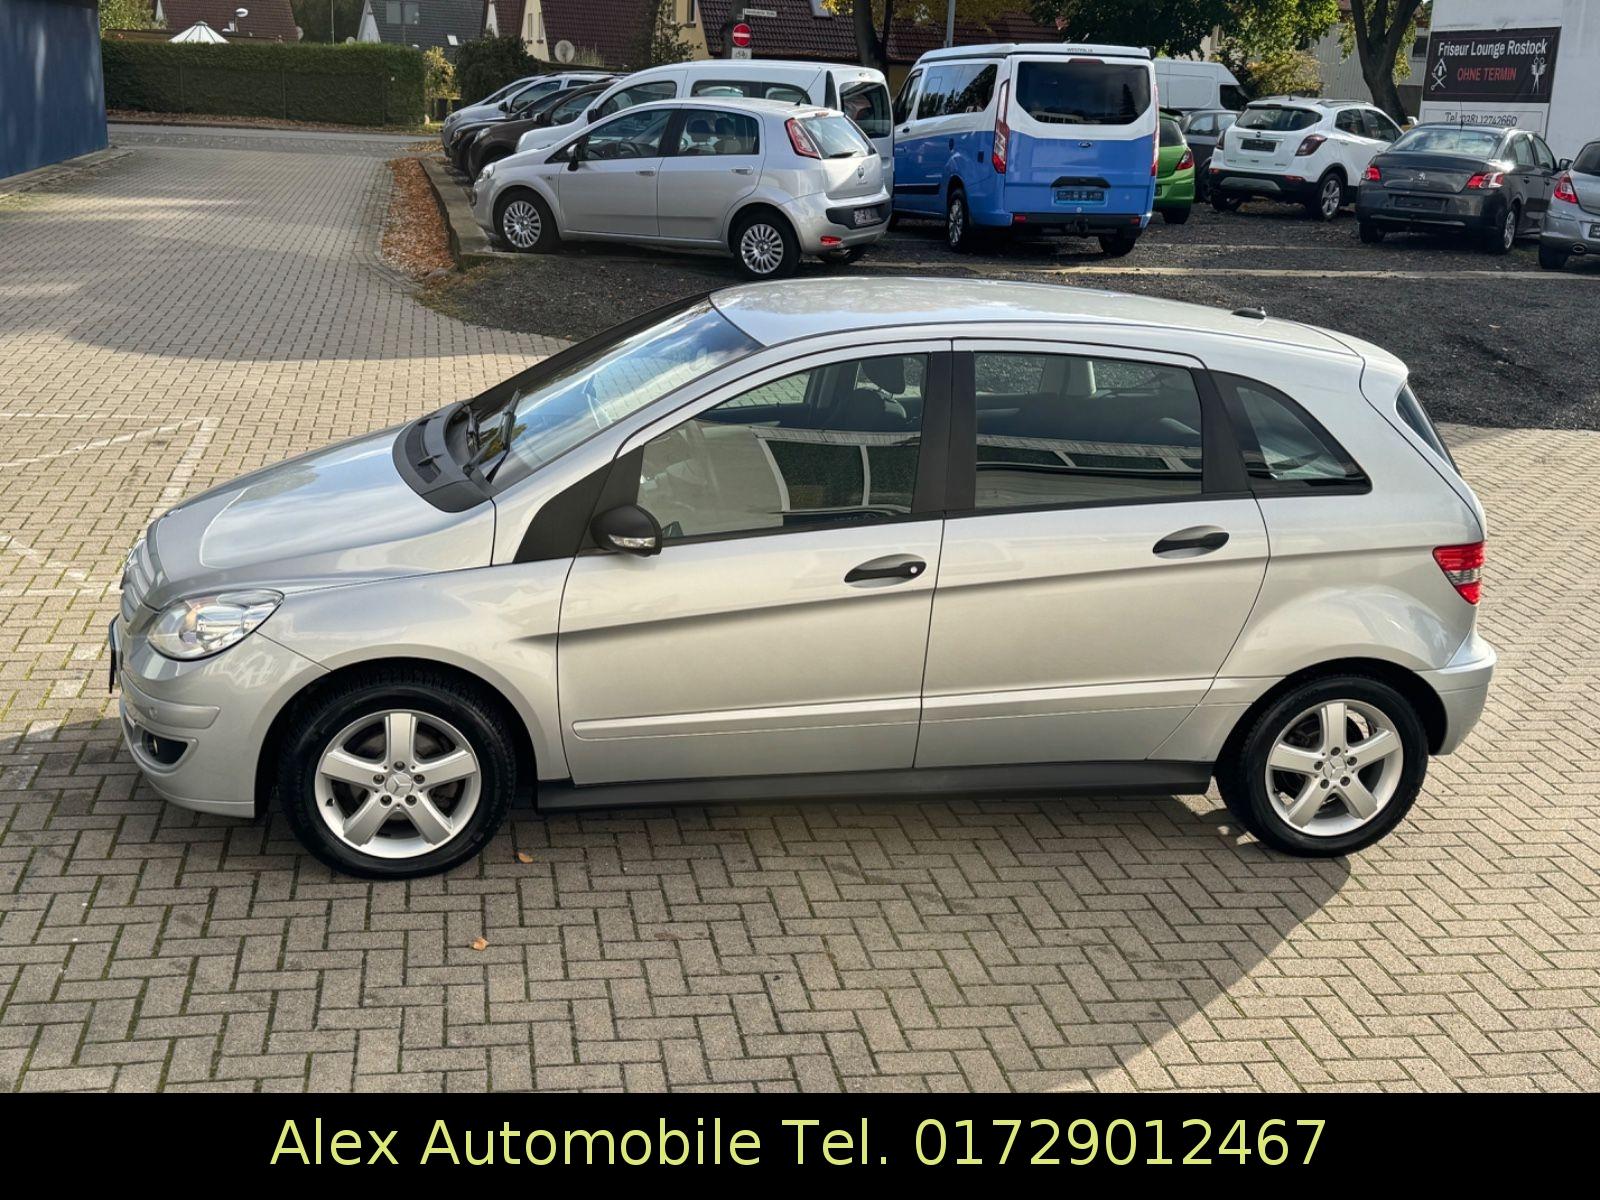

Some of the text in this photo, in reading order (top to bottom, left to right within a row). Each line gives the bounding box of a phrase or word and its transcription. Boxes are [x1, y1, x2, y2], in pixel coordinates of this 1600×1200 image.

[1438, 38, 1548, 59] Friseur Lounge Rostock
[1457, 67, 1517, 81] OHNE TERMIN
